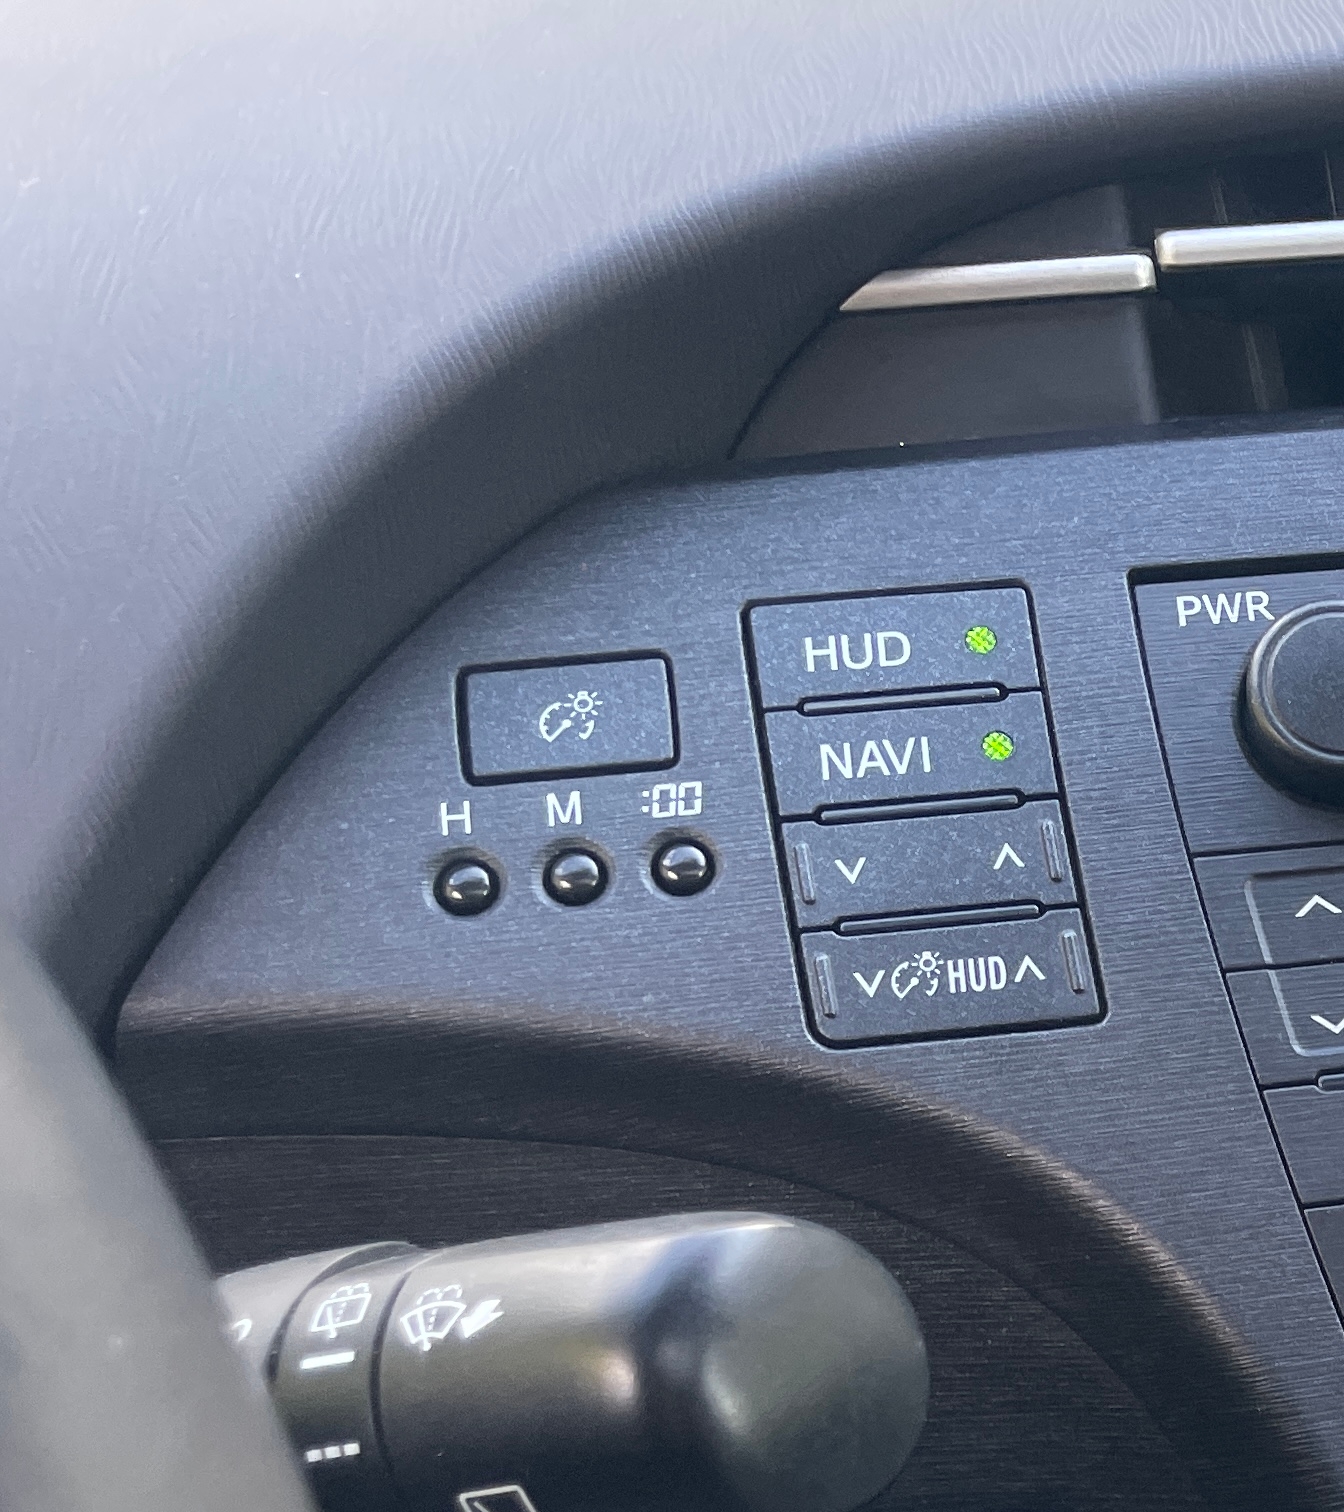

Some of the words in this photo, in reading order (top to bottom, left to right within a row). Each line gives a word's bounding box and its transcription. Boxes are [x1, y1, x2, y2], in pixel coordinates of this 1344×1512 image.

[1175, 589, 1276, 629] PWR
[803, 630, 911, 673] HUD
[819, 736, 931, 781] NAVI
[439, 800, 472, 836] H
[546, 790, 582, 827] M
[946, 955, 1008, 992] HUD
